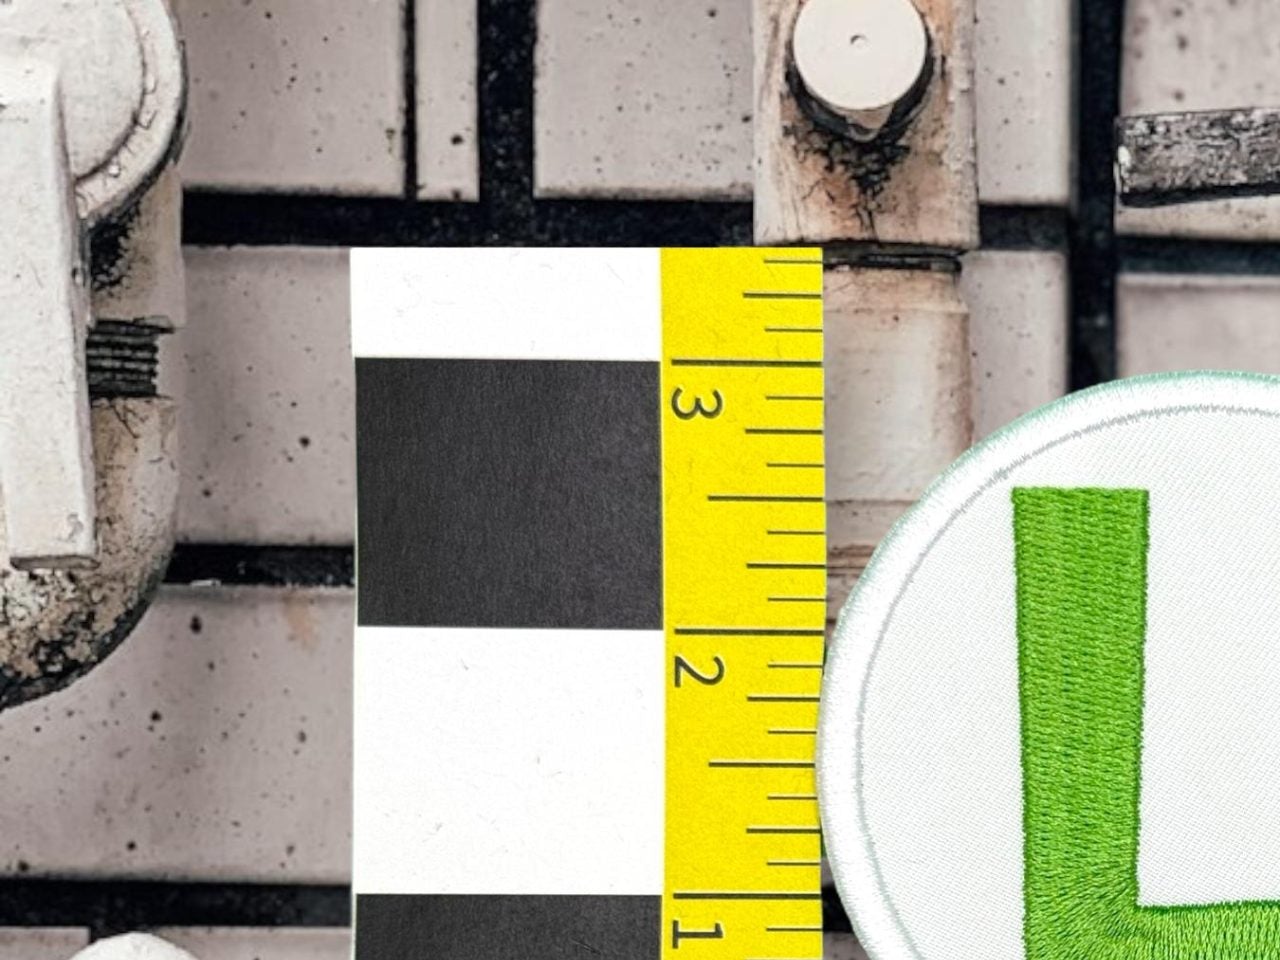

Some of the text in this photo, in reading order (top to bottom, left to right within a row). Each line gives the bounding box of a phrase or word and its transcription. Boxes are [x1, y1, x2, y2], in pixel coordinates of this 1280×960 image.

[671, 388, 724, 949] 3 2 1
